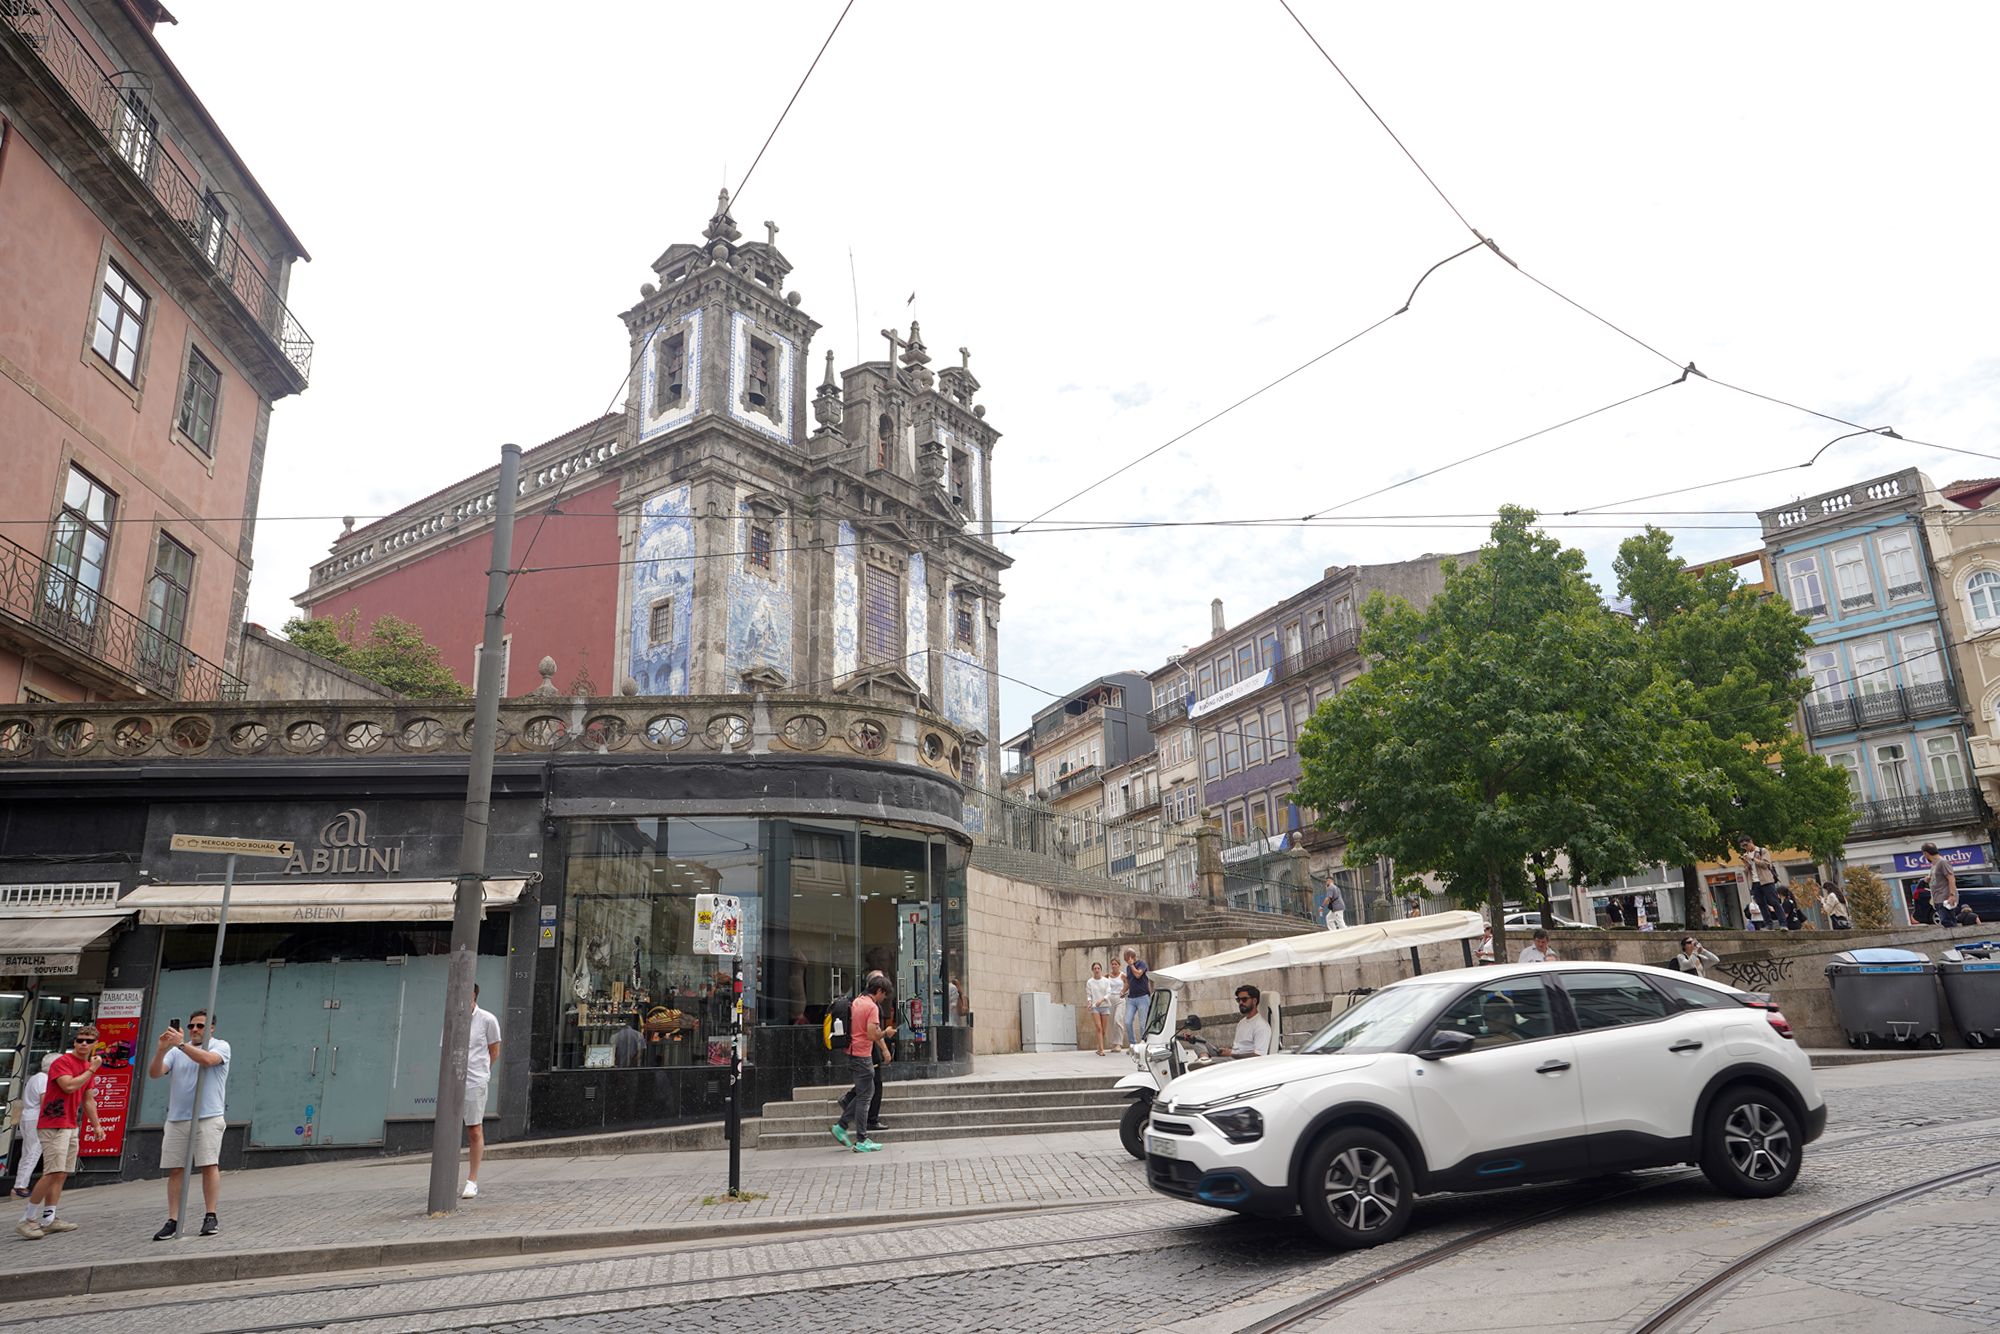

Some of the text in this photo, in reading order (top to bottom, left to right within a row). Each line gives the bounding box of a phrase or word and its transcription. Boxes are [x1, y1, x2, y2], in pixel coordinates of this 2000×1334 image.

[201, 839, 236, 847] MERCADO
[248, 842, 276, 850] BOLHÃO
[283, 847, 401, 875] ABILINI
[1904, 855, 1919, 868] Le
[293, 907, 345, 920] ABILINI
[5, 956, 46, 966] BATALHA
[34, 965, 74, 974] SOUVENIRS
[103, 992, 139, 1001] TABACARIA
